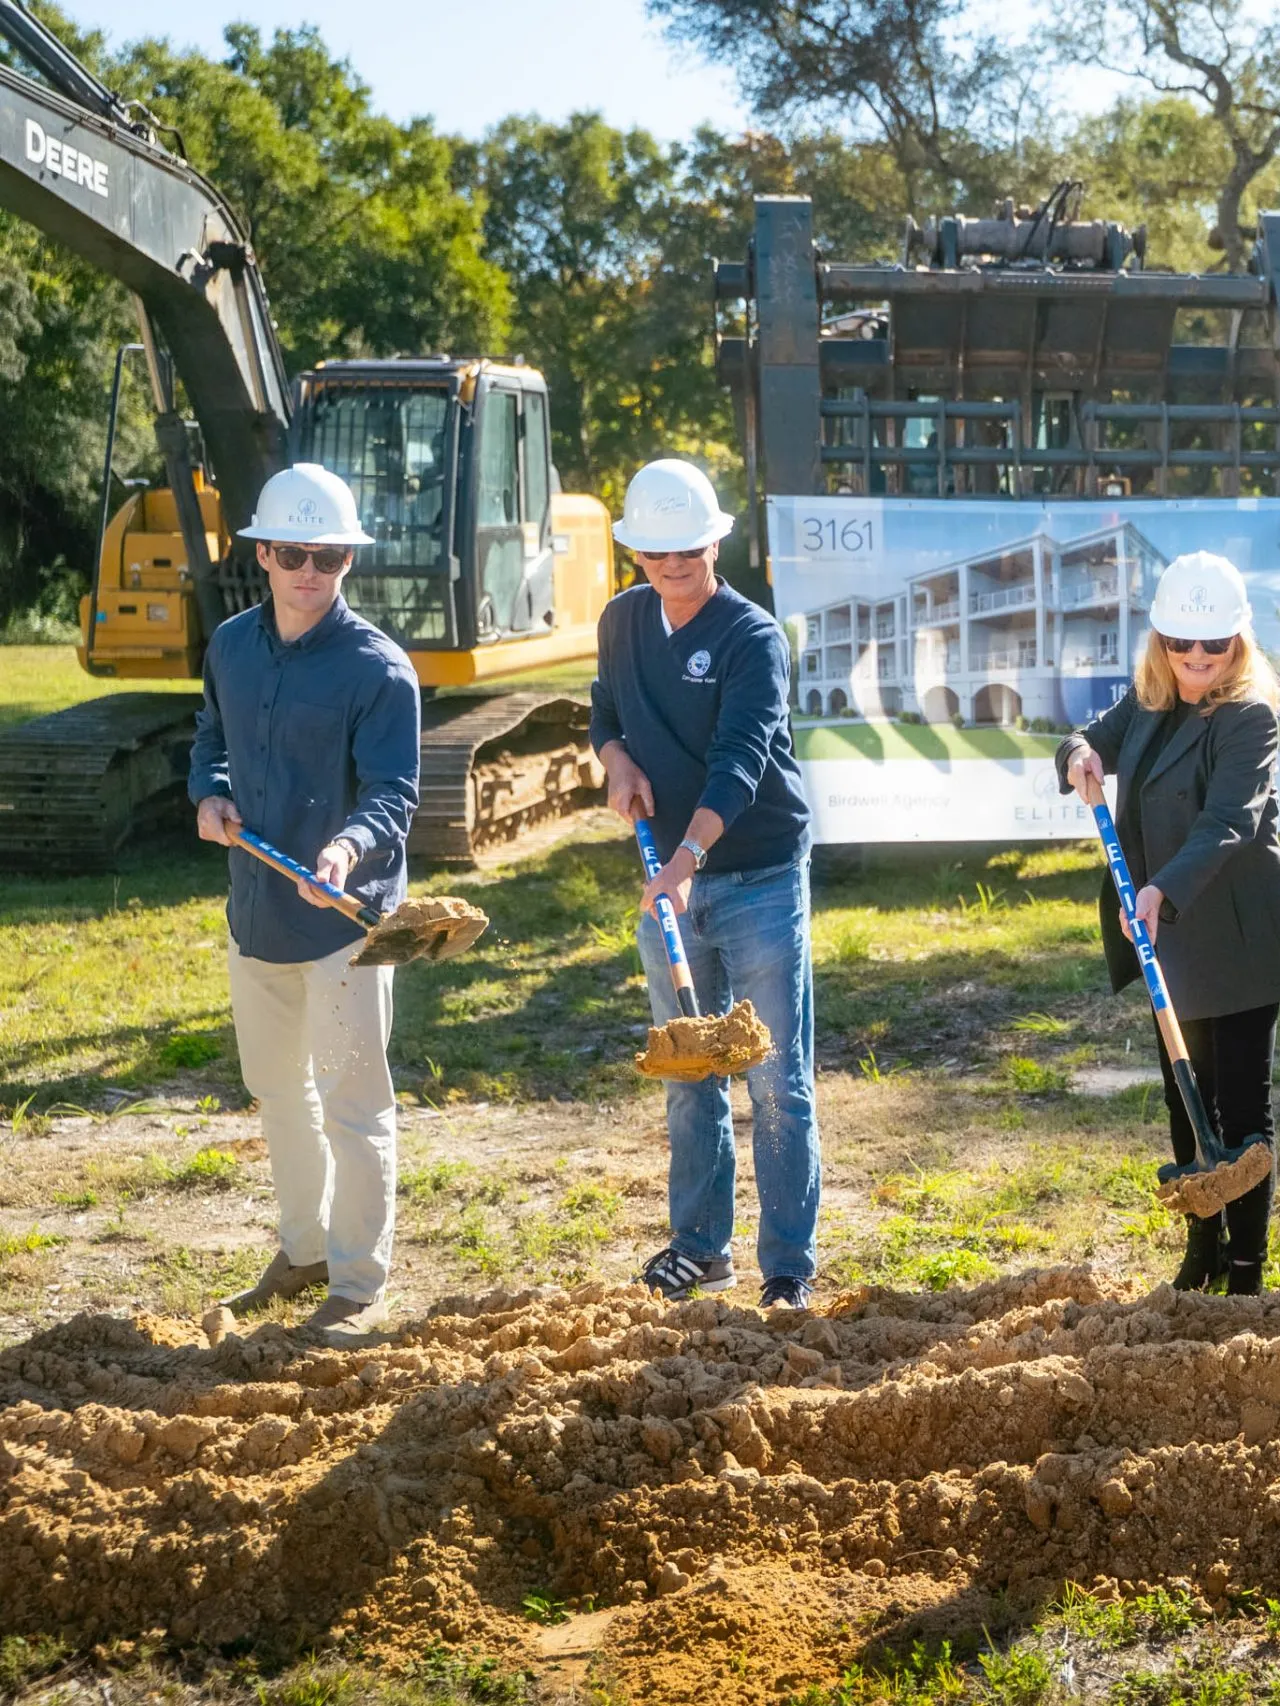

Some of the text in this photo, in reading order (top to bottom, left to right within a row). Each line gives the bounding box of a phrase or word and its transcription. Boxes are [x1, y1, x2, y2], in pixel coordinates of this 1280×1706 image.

[25, 118, 109, 198] DEERE
[288, 515, 325, 525] ELITE
[803, 517, 873, 552] 3161
[1180, 603, 1216, 613] ELITE
[1014, 805, 1087, 820] ELITE
[1106, 842, 1155, 966] ELITE
